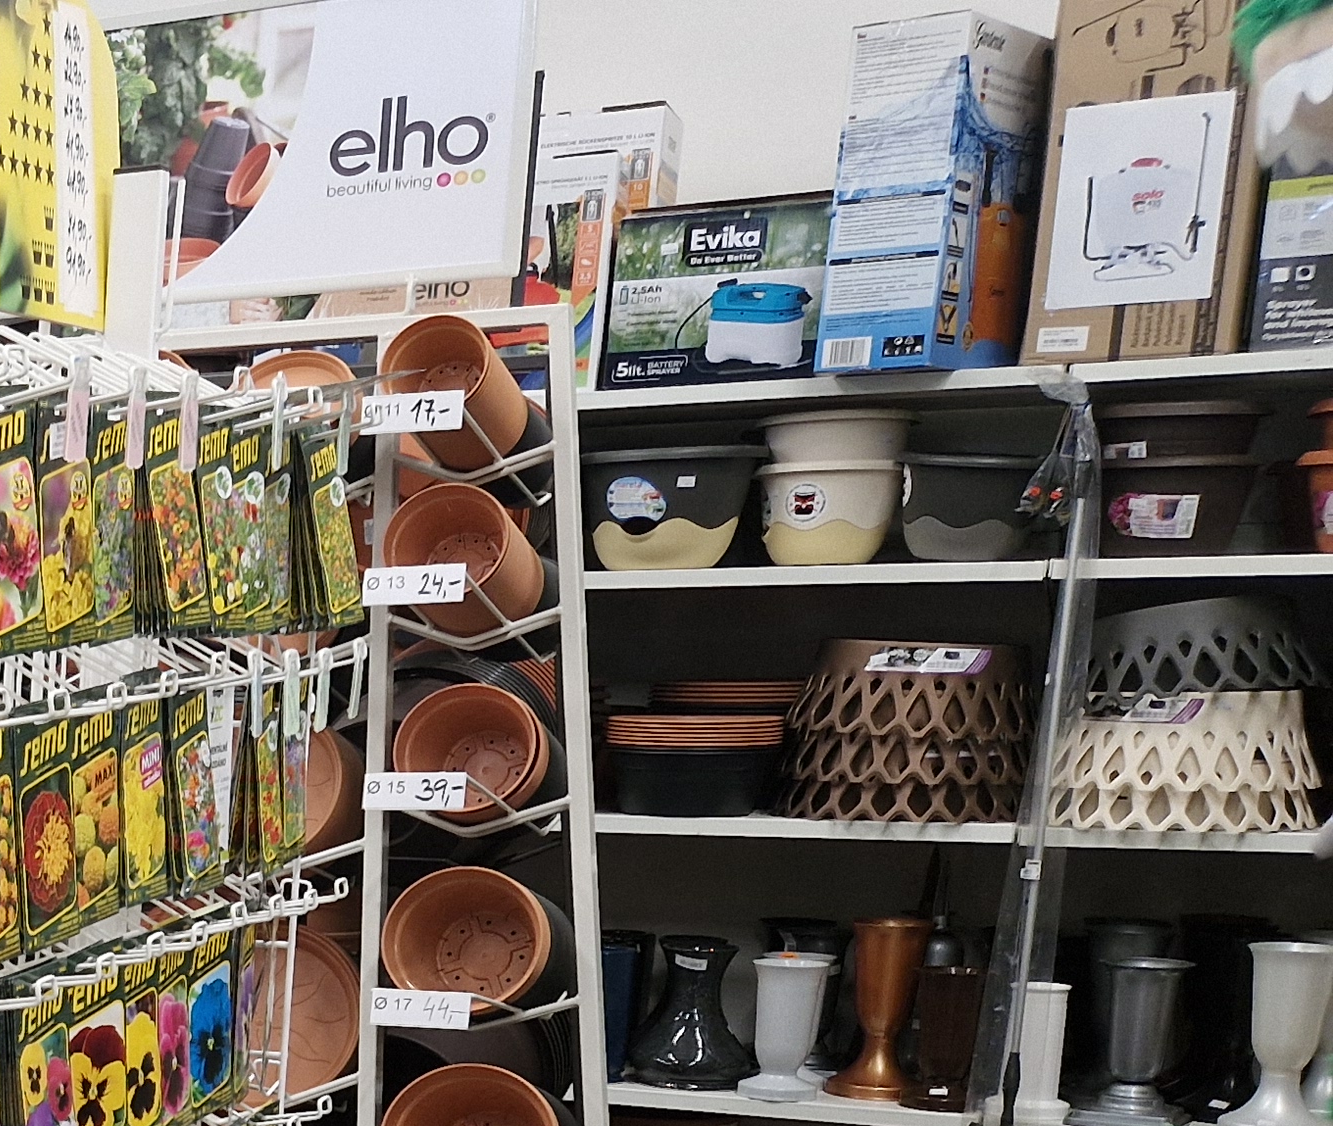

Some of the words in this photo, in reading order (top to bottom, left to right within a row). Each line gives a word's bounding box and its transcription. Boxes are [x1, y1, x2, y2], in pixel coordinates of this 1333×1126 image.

[329, 95, 490, 178] elho
[326, 178, 390, 198] beautiful
[395, 175, 433, 194] living
[690, 225, 761, 252] Evika
[647, 359, 684, 368] BATTERY
[388, 576, 405, 588] 13
[141, 748, 161, 770] MINI
[94, 765, 115, 786] MAXI
[388, 781, 405, 793] 15
[394, 999, 411, 1010] 17
